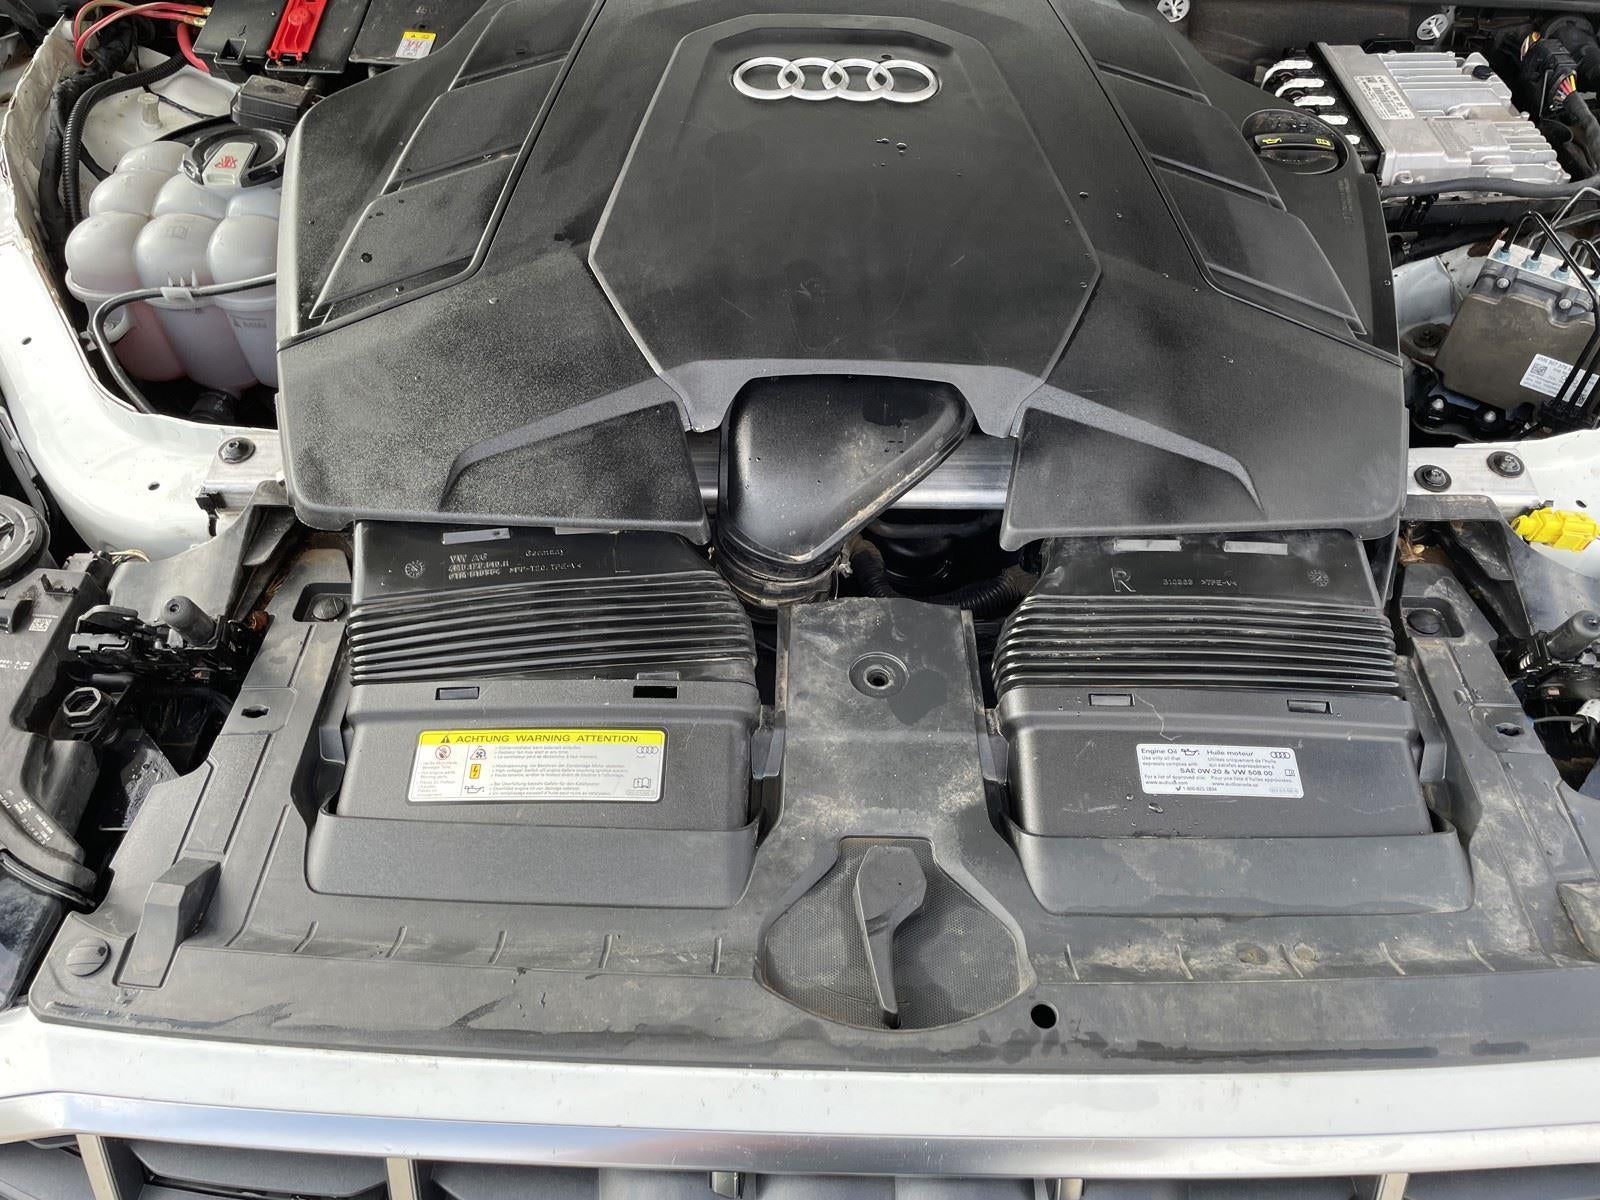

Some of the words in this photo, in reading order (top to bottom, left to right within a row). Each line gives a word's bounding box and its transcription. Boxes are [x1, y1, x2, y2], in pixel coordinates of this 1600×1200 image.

[1110, 567, 1136, 592] R
[455, 734, 510, 743] ACHTUNG
[515, 734, 571, 742] WARNING
[576, 734, 639, 743] ATTENTION
